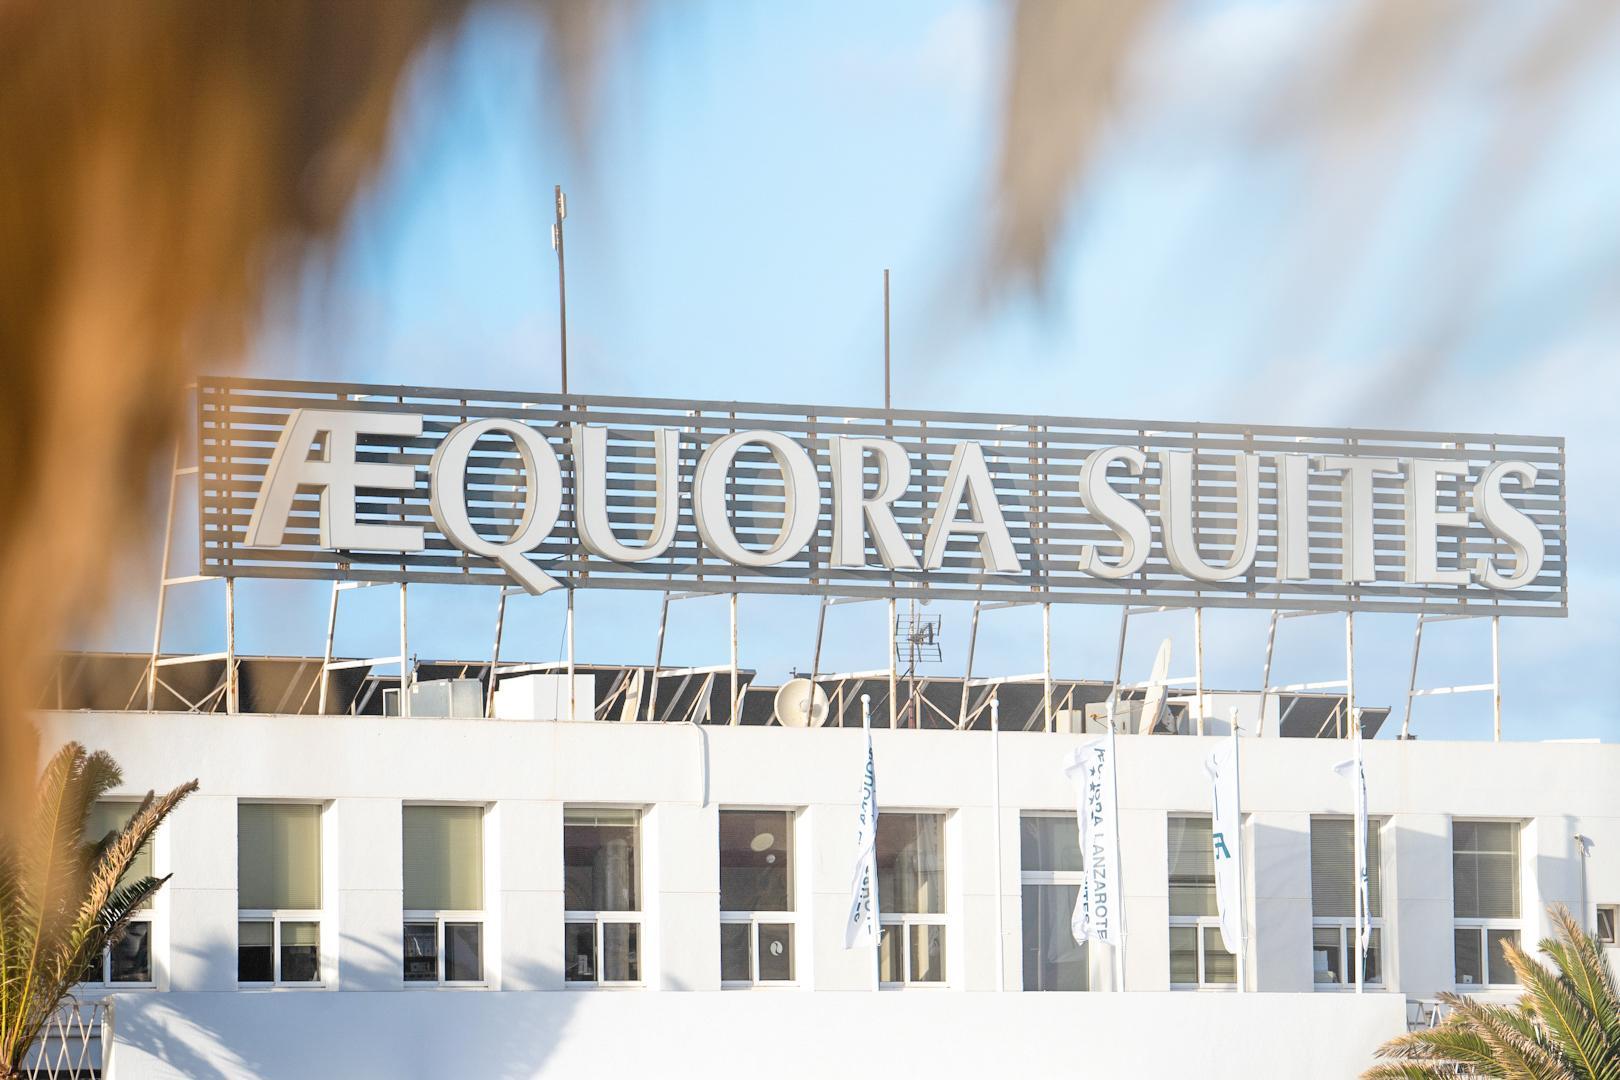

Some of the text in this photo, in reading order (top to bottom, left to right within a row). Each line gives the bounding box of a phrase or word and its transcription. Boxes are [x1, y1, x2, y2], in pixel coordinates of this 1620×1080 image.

[243, 408, 1546, 596] ÆQUORA SUITES
[1092, 832, 1108, 941] LANZAROTE
